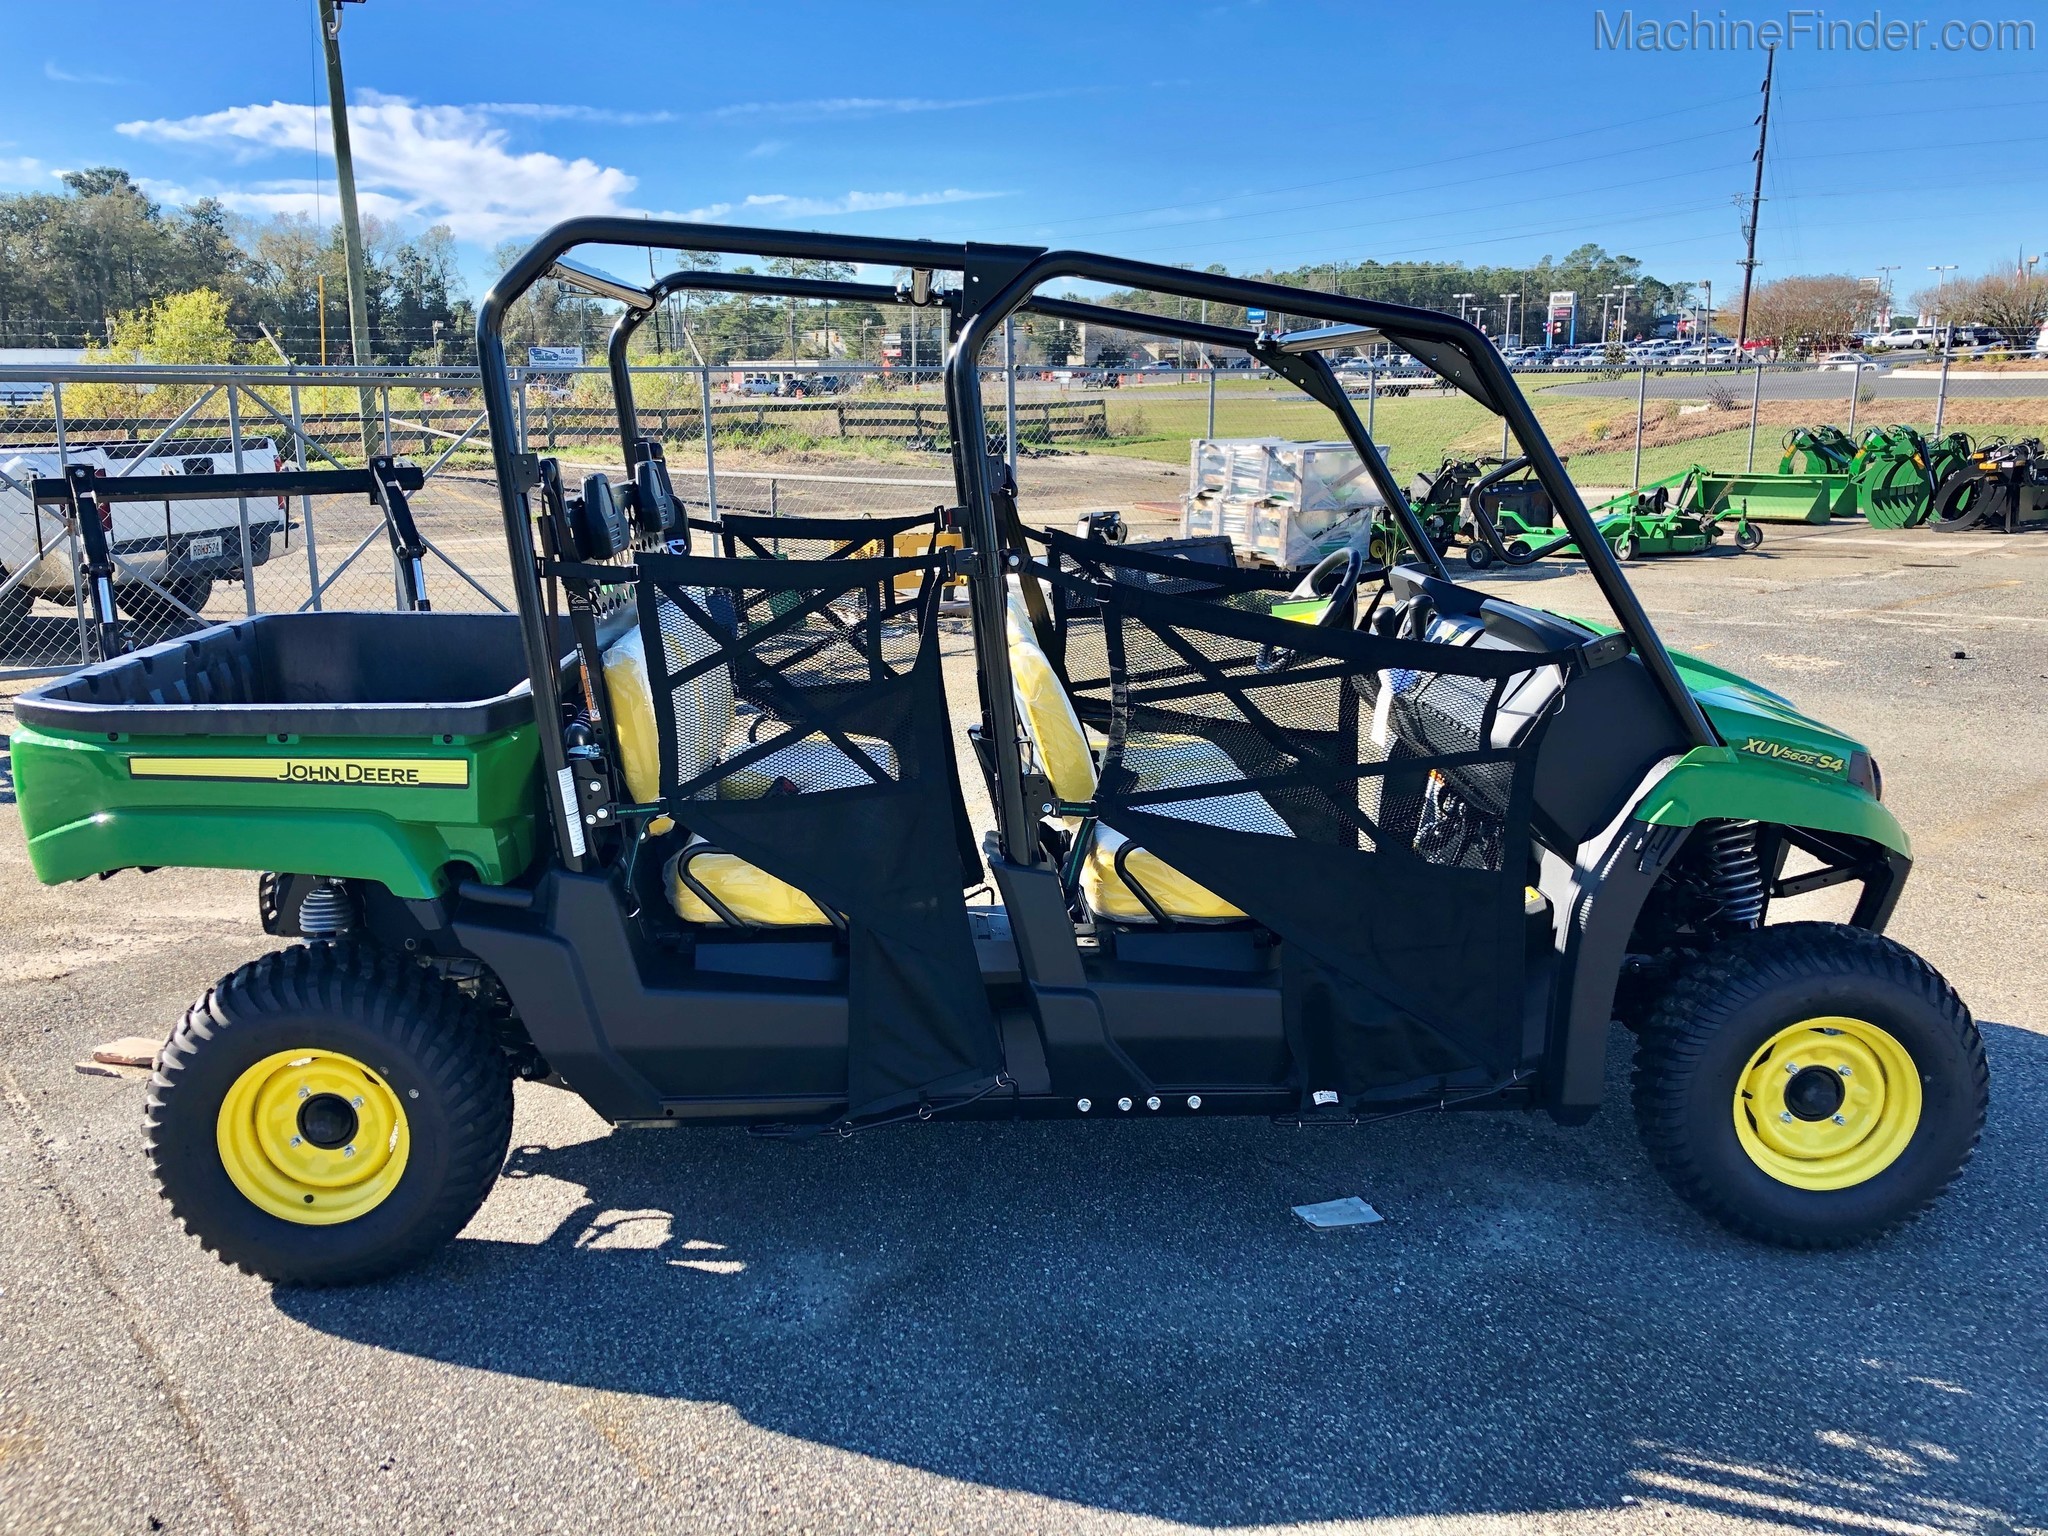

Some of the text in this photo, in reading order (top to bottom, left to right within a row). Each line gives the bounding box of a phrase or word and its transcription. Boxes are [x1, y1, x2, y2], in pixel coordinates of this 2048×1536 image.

[1741, 738, 1845, 773] XUV560E S4
[278, 762, 419, 783] JOHN DEERE
